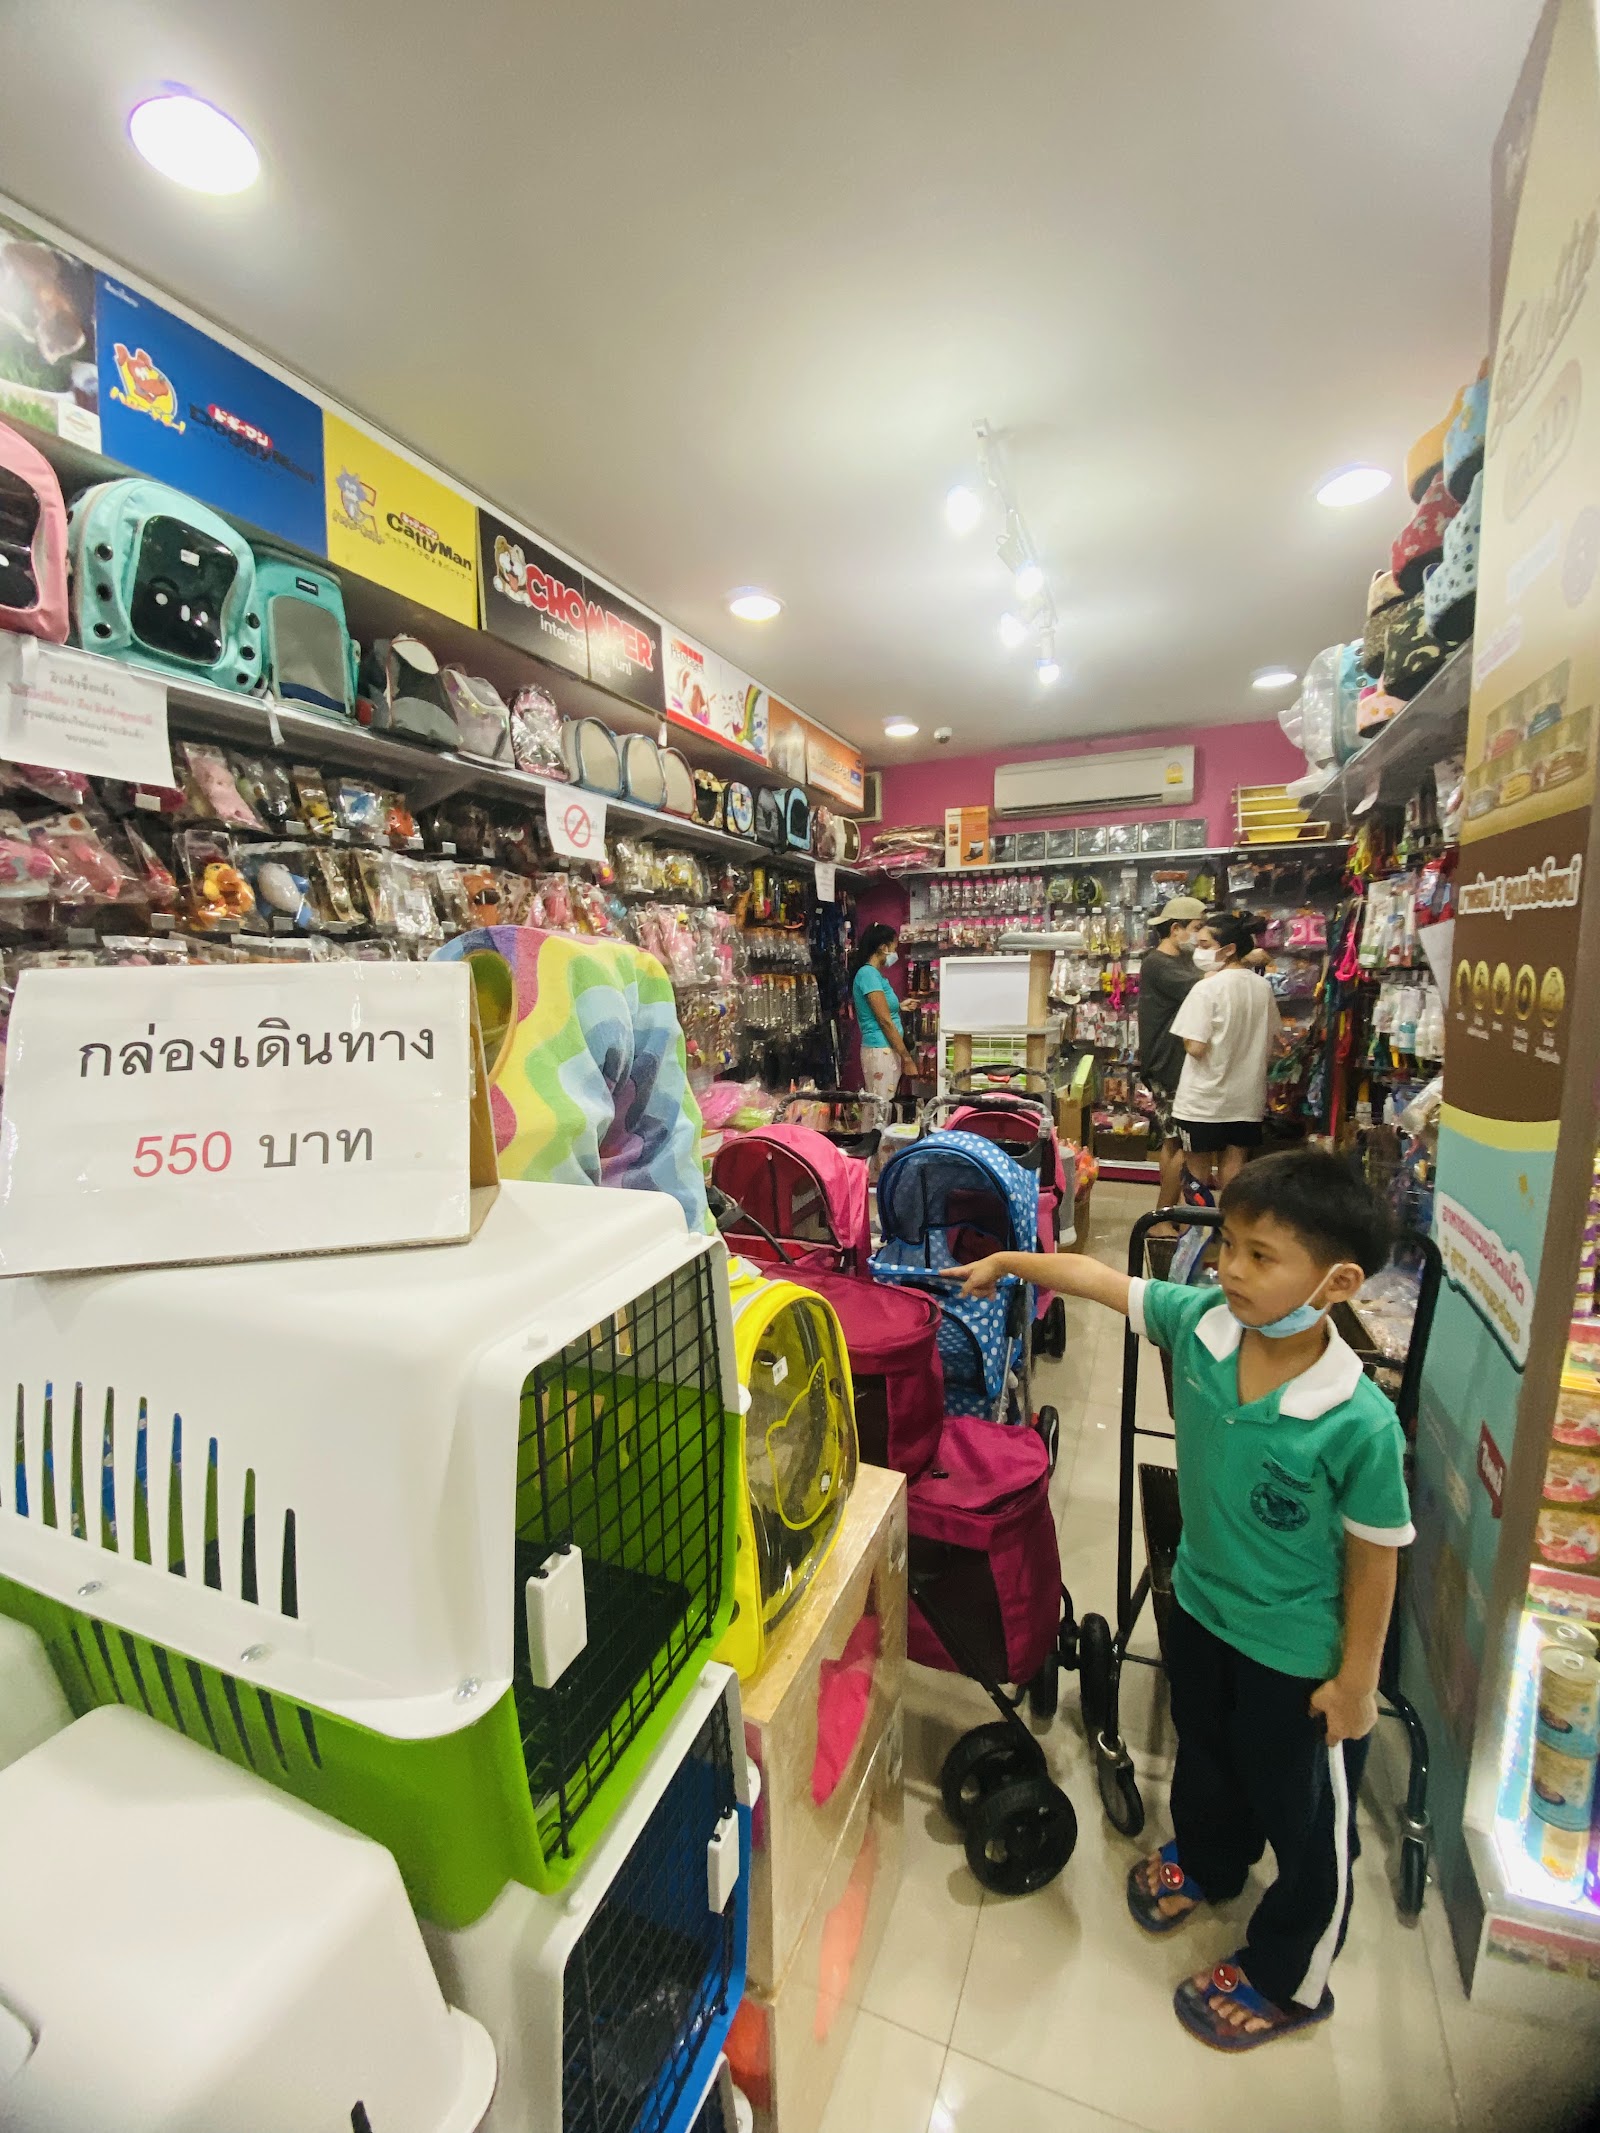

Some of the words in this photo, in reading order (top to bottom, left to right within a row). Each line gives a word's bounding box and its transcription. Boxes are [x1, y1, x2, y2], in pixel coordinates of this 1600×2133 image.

[386, 512, 472, 571] CattyMan
[526, 563, 654, 672] CHOMPER
[78, 1016, 435, 1078] กล่องเดินทาง
[132, 1130, 233, 1178] 550
[258, 1126, 374, 1169] บาท
